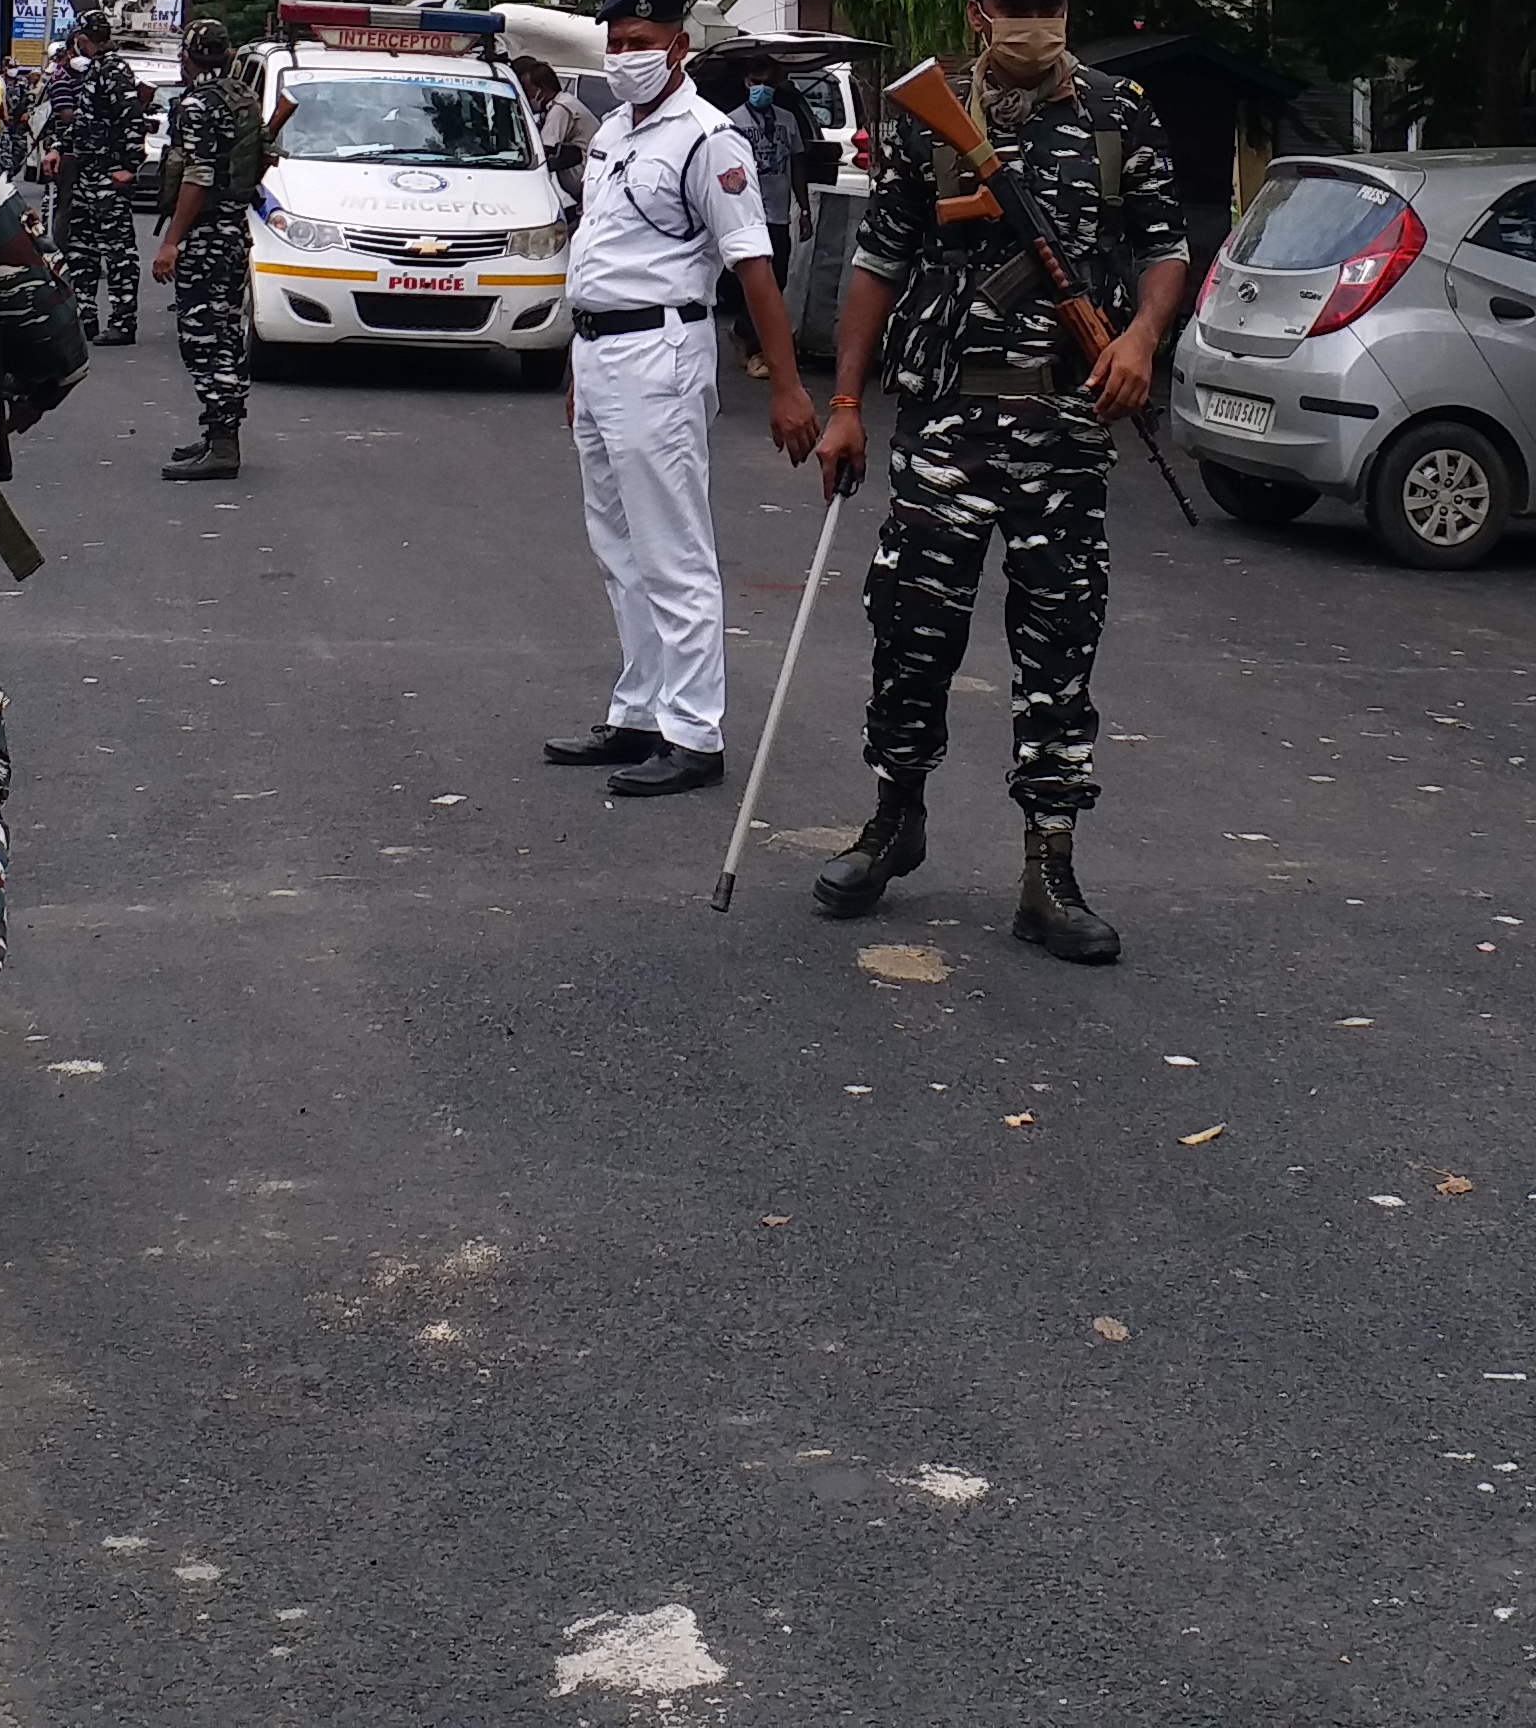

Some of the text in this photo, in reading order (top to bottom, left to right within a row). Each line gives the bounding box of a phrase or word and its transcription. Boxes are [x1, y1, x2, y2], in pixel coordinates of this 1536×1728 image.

[142, 22, 168, 30] PRESS
[338, 30, 453, 50] INTERCEPTOR
[1356, 184, 1391, 205] PRESS
[340, 195, 516, 215] INTERCEPTOR
[388, 276, 464, 291] POLICE
